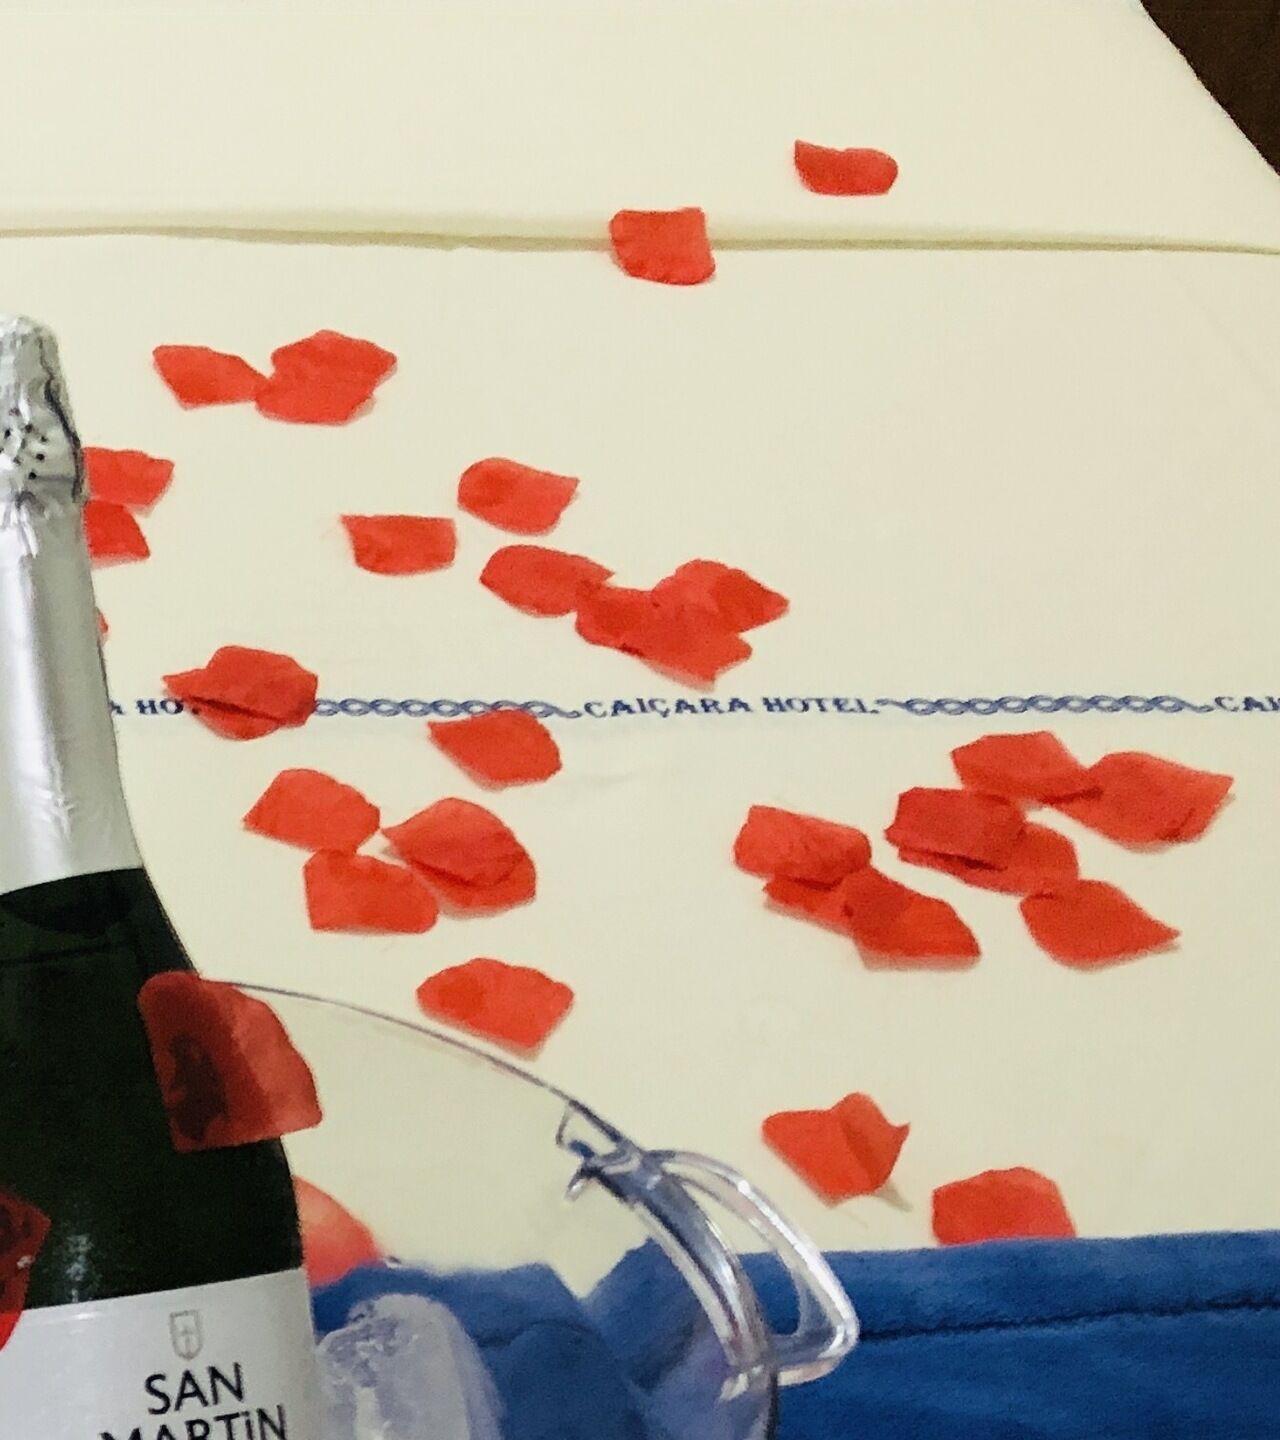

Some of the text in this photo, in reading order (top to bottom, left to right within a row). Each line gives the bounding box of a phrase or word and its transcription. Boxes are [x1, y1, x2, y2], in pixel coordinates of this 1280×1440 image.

[584, 697, 880, 718] CAIÇARA HOTEL
[144, 1362, 244, 1415] SAN
